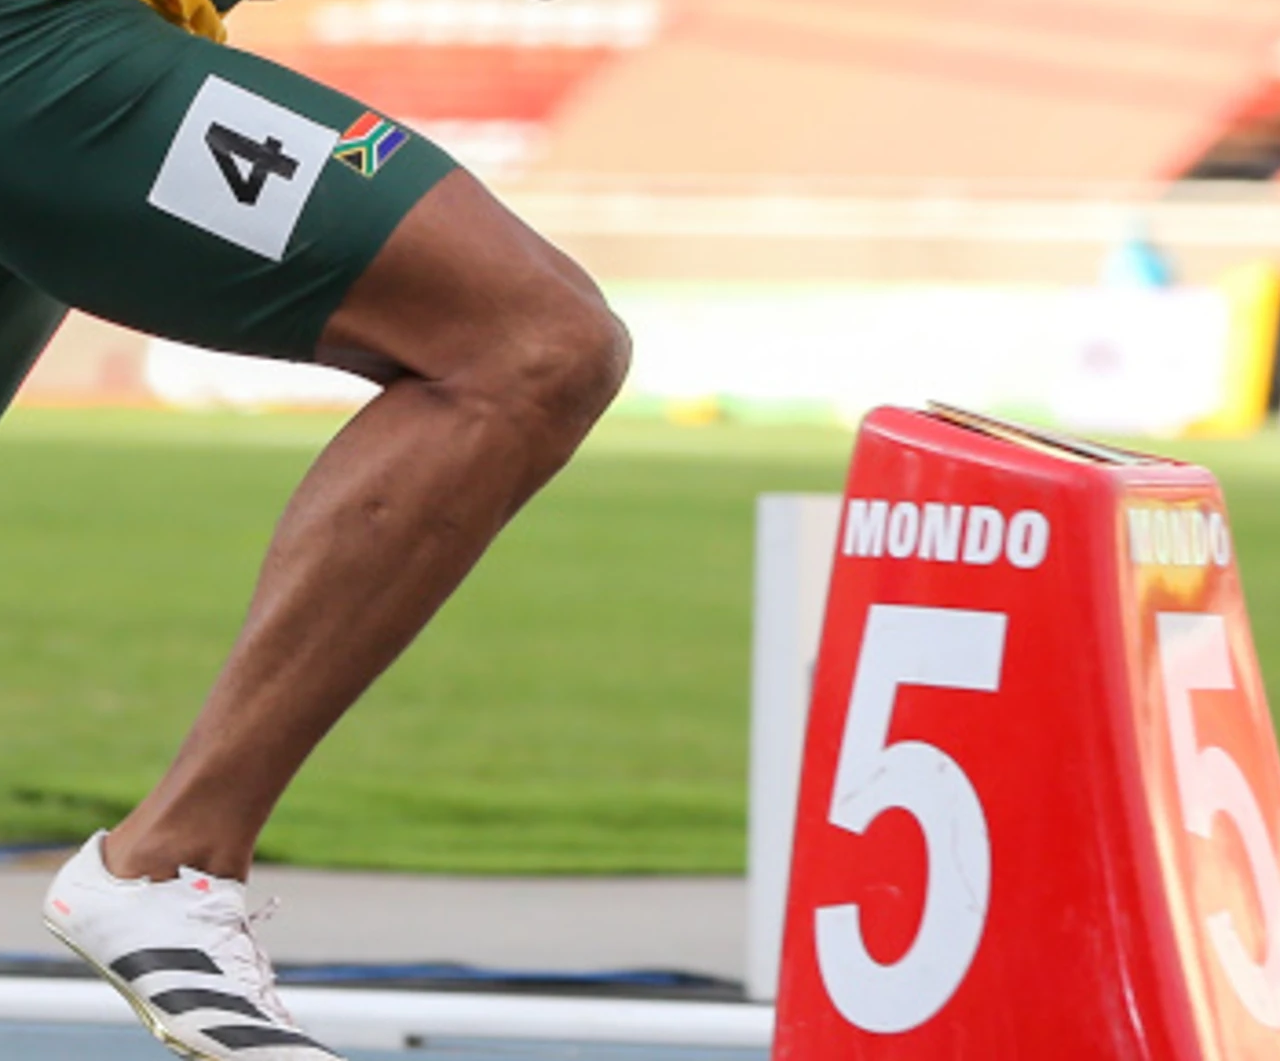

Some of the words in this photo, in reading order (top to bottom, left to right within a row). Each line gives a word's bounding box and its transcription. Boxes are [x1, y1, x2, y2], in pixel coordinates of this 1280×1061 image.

[204, 121, 301, 206] 4
[842, 500, 1051, 568] MONDO
[1128, 508, 1231, 567] MONDO
[814, 603, 1008, 1034] 5
